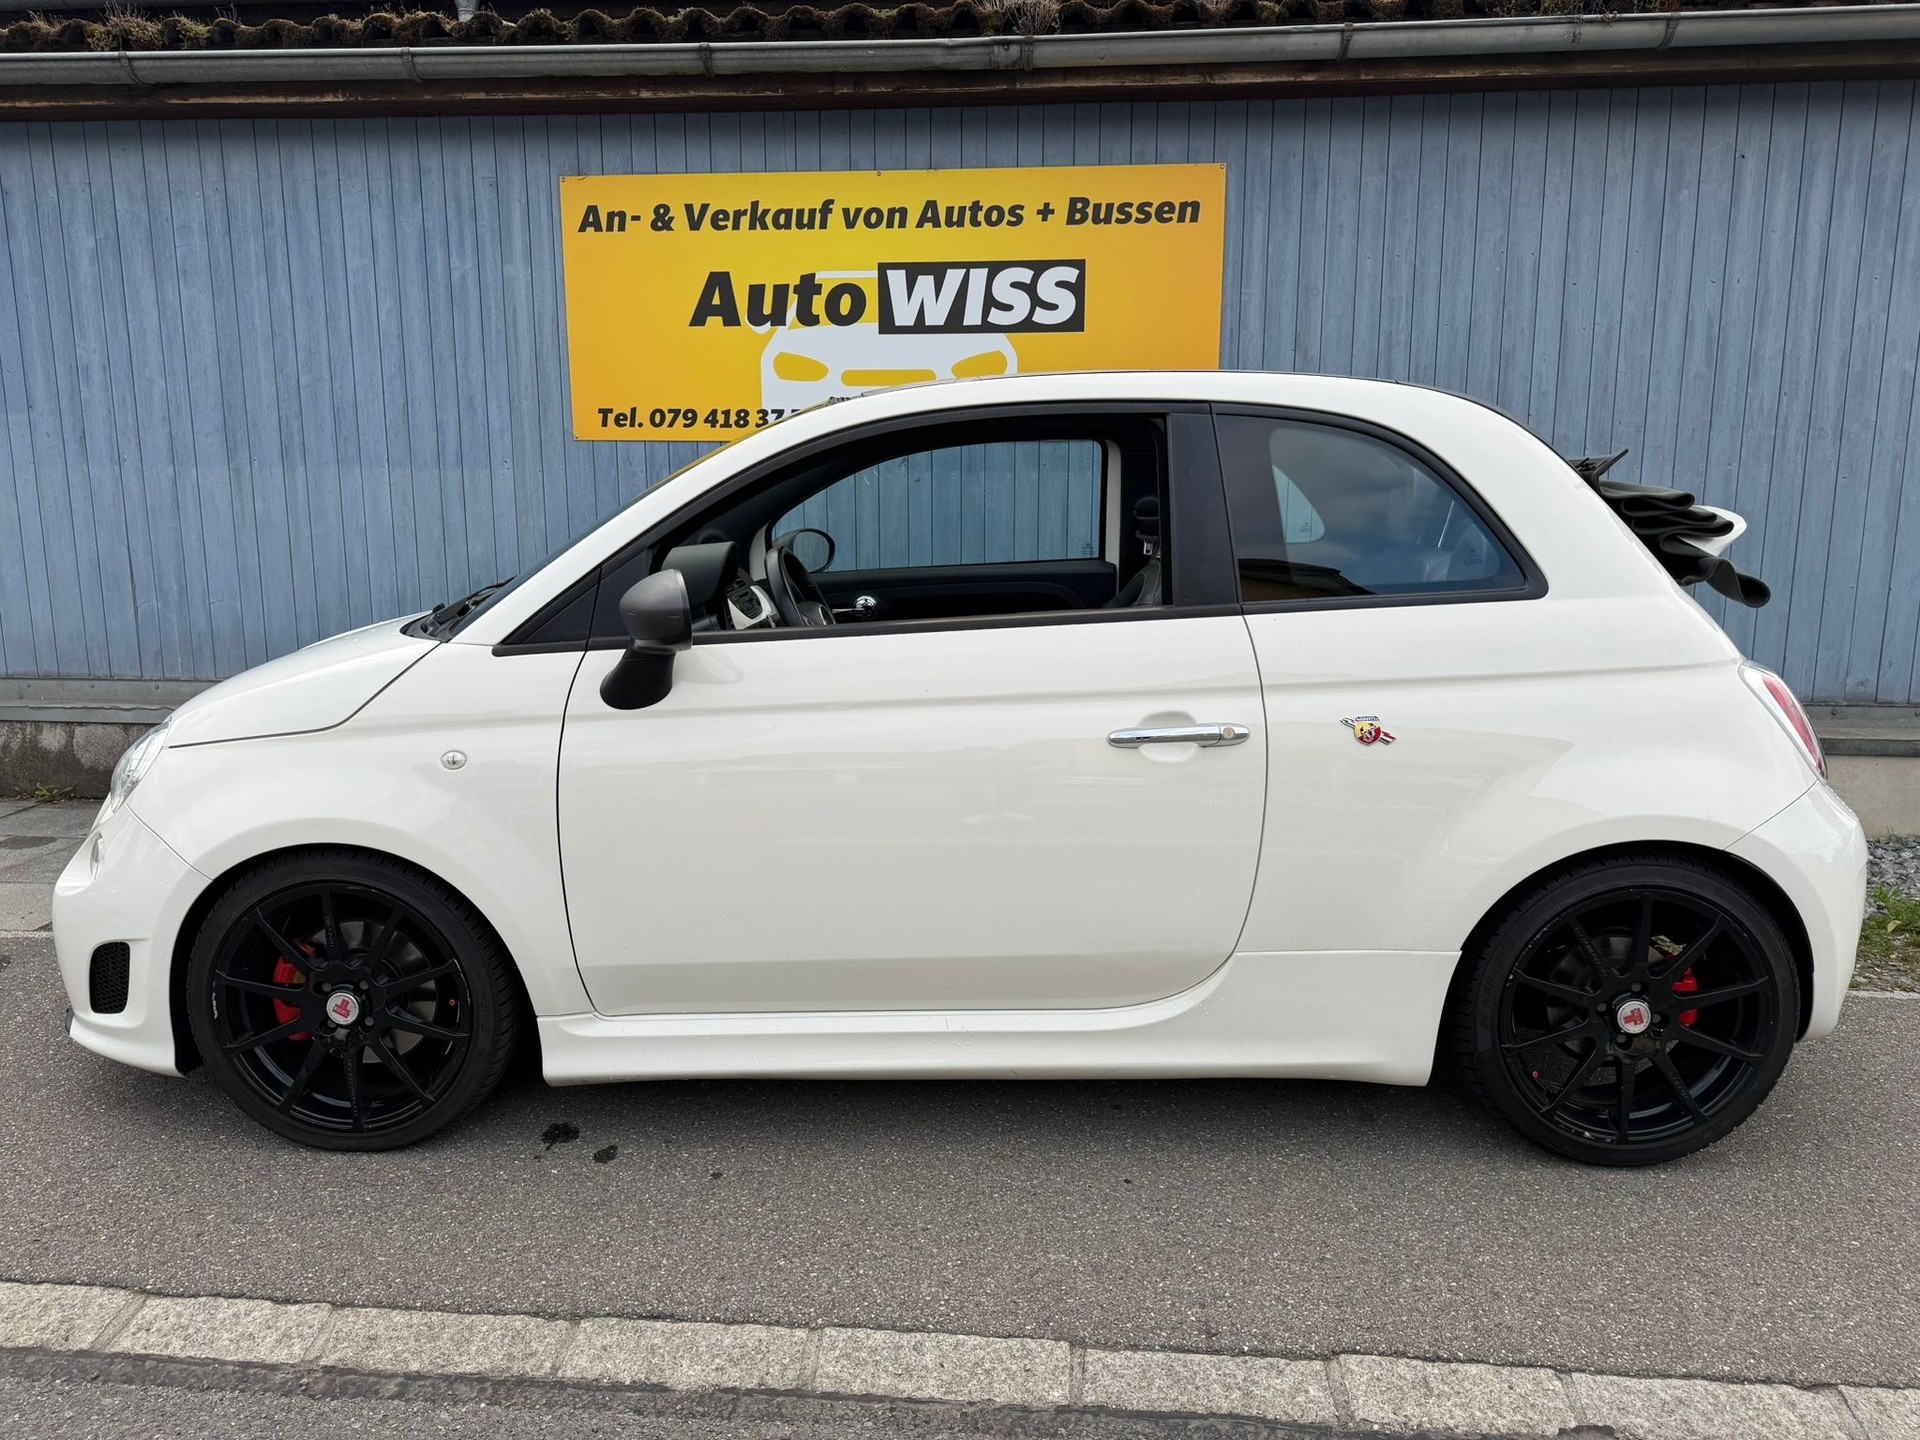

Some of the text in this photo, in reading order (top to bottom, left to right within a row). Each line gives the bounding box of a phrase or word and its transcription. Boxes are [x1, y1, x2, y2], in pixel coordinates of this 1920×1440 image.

[578, 196, 1201, 233] An- & Verkauf von Autos + Bussen
[688, 266, 1080, 328] Auto WISS
[597, 406, 644, 428] Tel.
[649, 408, 698, 429] 079
[703, 408, 750, 429] 418
